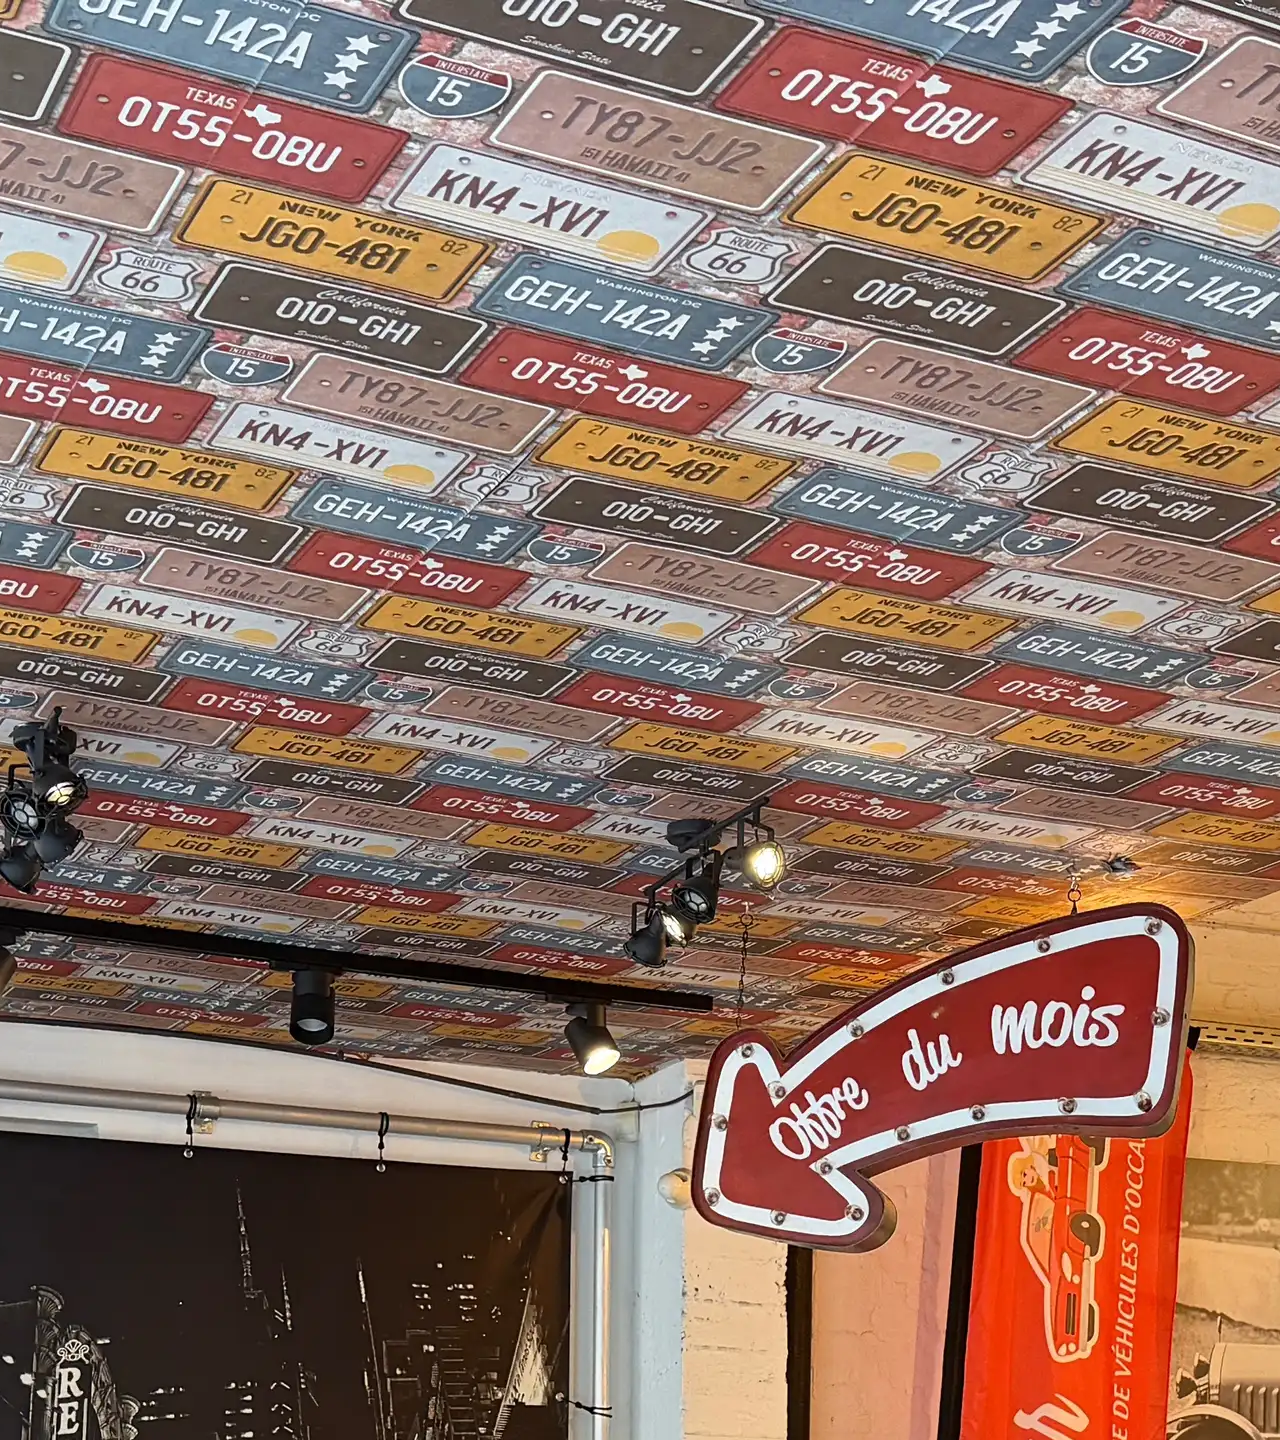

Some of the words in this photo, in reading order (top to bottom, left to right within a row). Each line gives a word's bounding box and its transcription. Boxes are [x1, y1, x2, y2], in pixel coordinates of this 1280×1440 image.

[859, 58, 915, 81] TEXAS
[1107, 41, 1167, 75] 15
[503, 274, 692, 339] GEH-142A
[476, 482, 515, 496] 66
[798, 484, 956, 531] GEH-142A
[544, 545, 579, 560] 15
[176, 650, 314, 685] GEH-142A
[769, 1075, 871, 1161] Offre
[901, 1028, 963, 1091] du
[991, 985, 1125, 1055] mois
[1122, 1137, 1147, 1236] D'OCCA
[1111, 1238, 1140, 1377] VÉHICULES
[1113, 1383, 1131, 1421] DE
